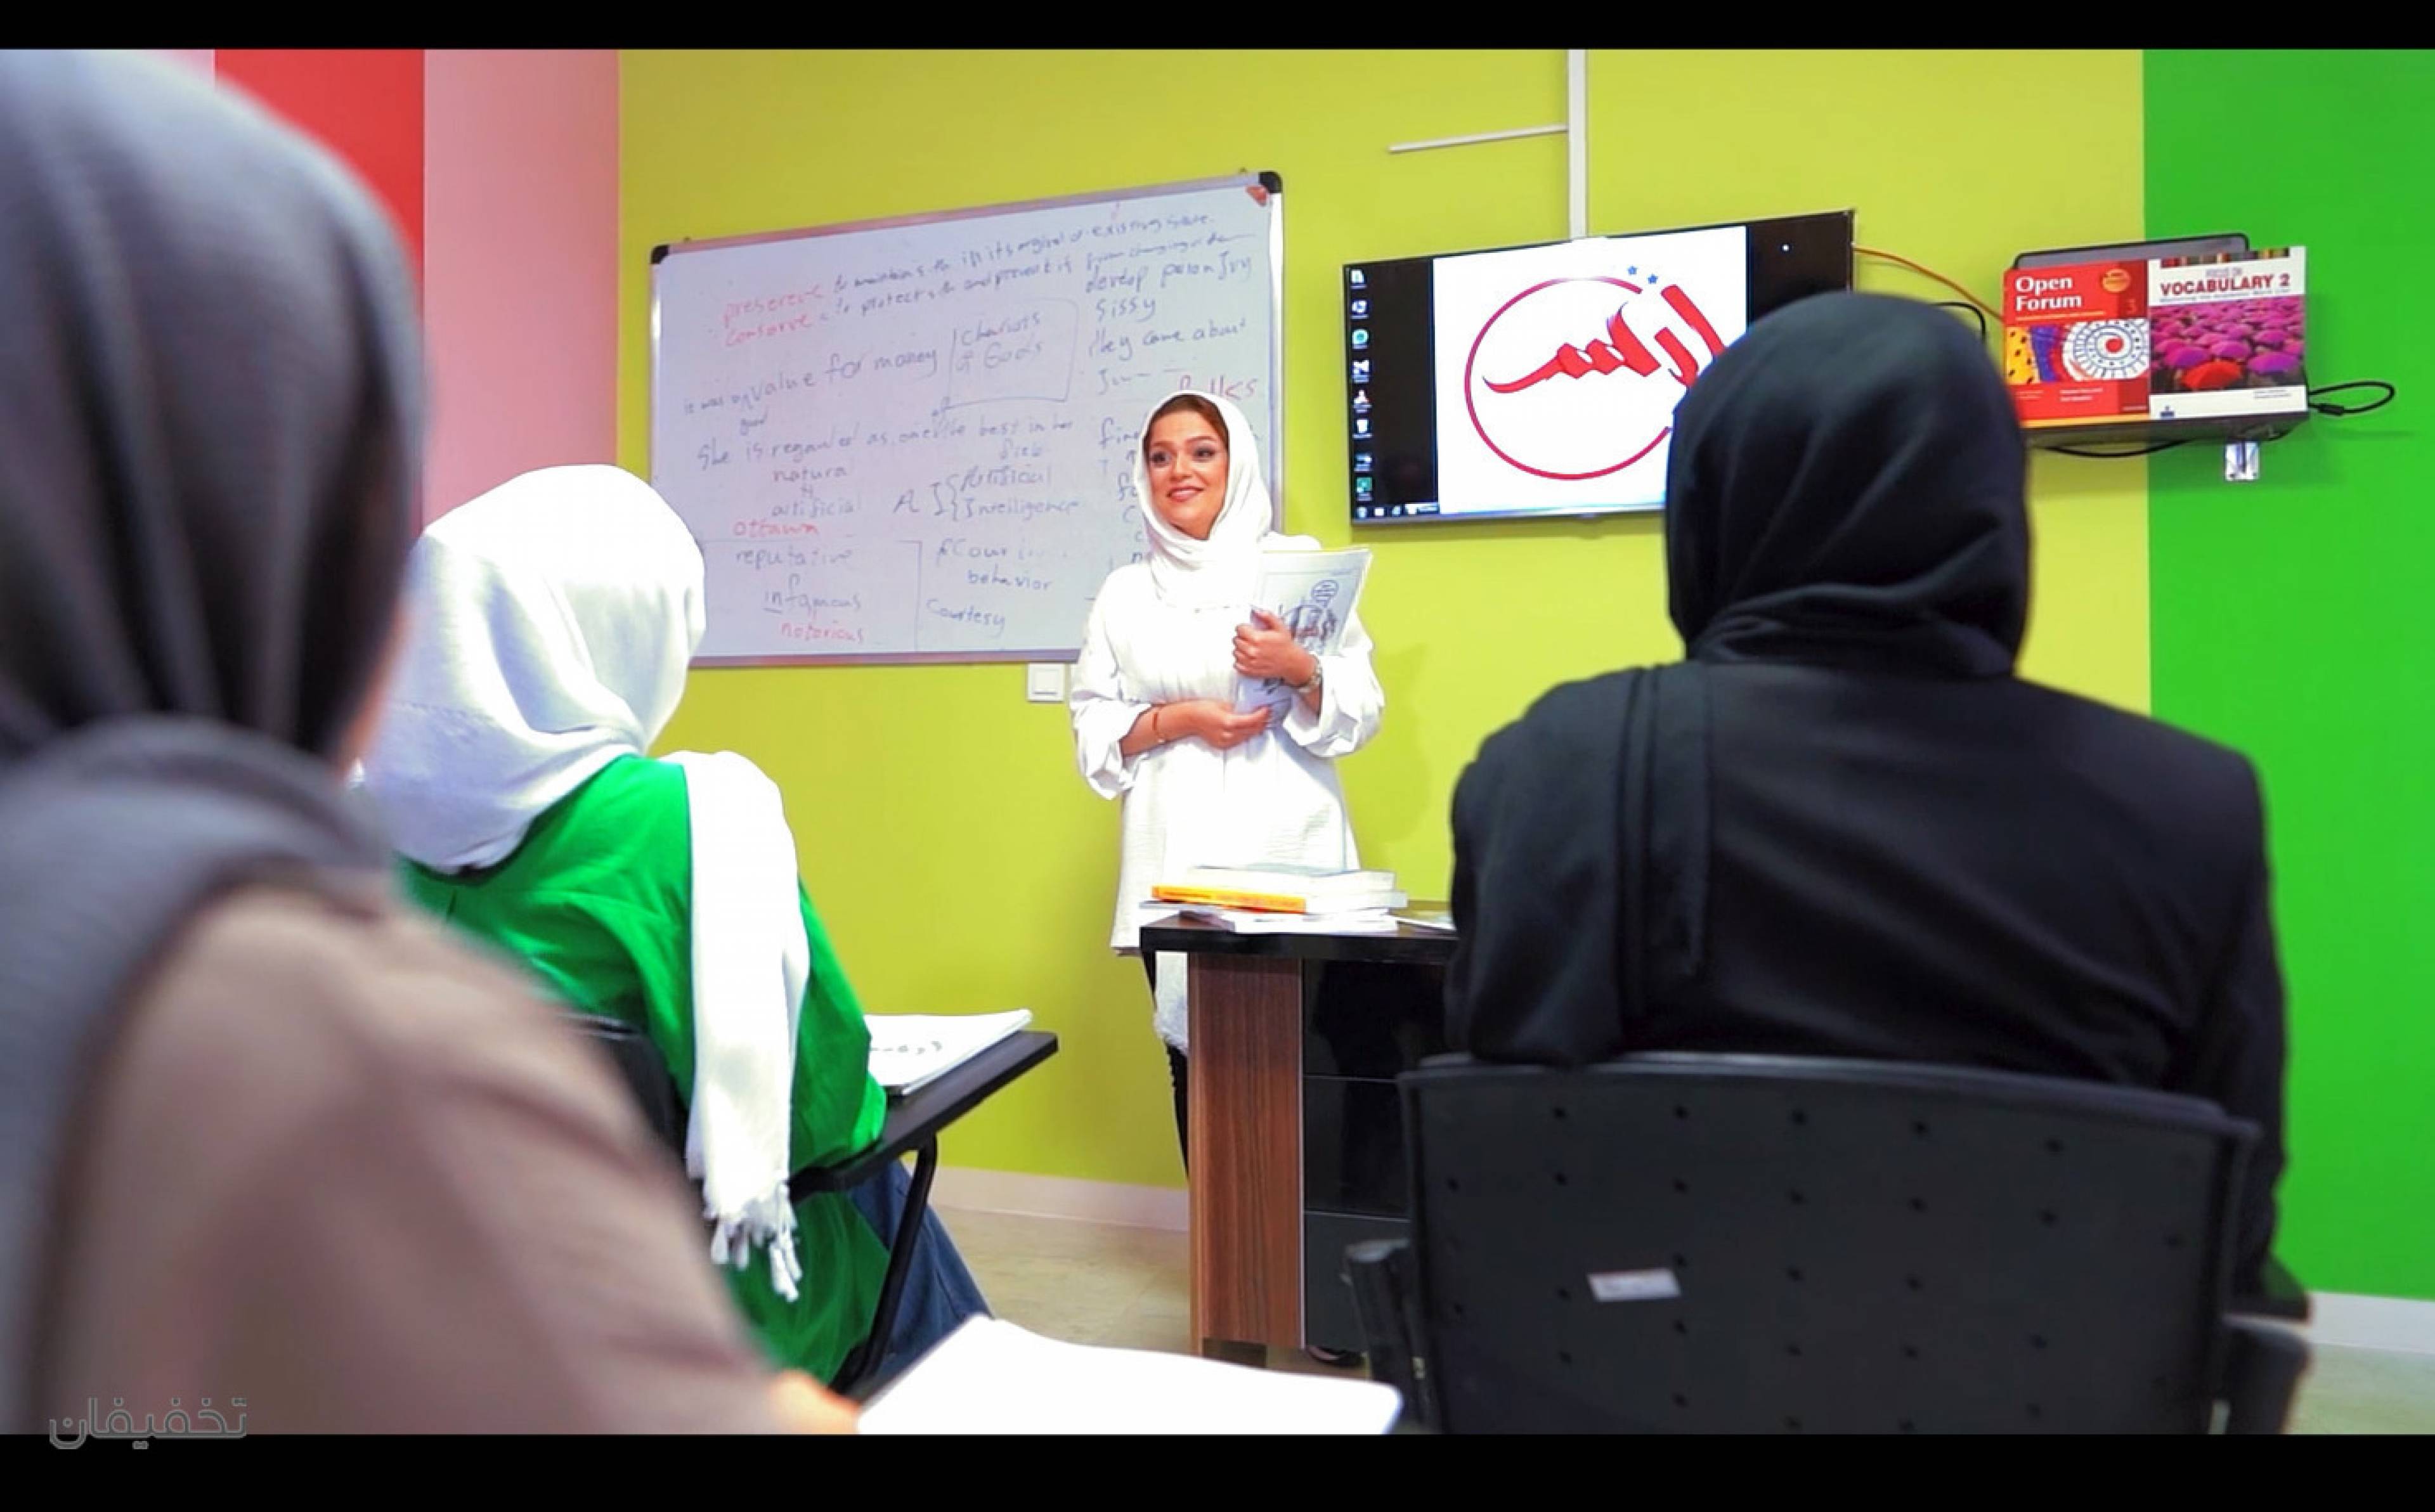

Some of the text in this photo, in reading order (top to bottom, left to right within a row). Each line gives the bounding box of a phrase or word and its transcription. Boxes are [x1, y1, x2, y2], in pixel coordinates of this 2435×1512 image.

[2015, 276, 2074, 296] Open
[2160, 273, 2275, 296] VOCABULARY
[2279, 272, 2291, 287] 2
[2015, 295, 2082, 311] Forum
